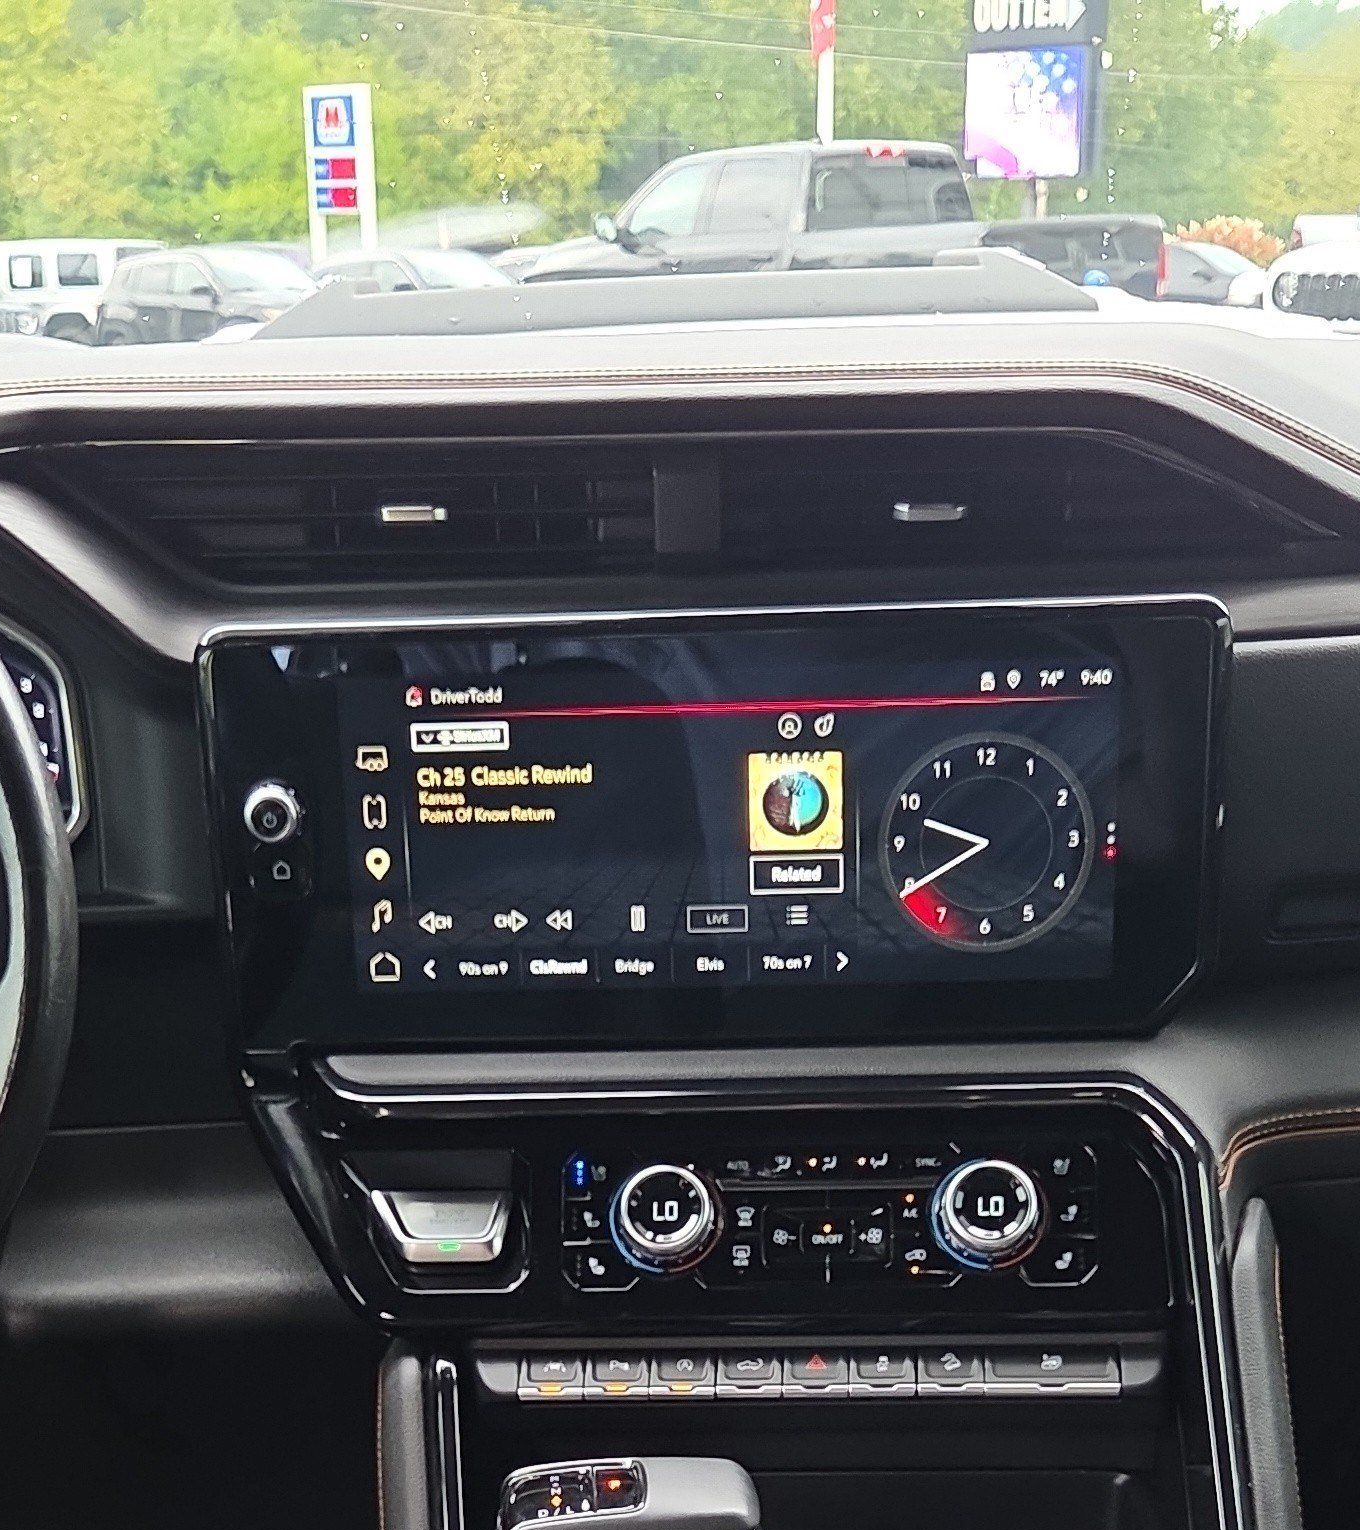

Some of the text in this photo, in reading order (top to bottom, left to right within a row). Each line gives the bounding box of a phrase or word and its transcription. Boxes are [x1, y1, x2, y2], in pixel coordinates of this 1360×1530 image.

[1080, 669, 1113, 686] 9:40
[976, 747, 996, 766] 12
[416, 763, 593, 787] Ch 25 Classic Rewind
[932, 760, 952, 778] 11
[1026, 758, 1035, 776] 1
[418, 790, 466, 806] Kansas
[900, 793, 921, 811] 10
[1056, 789, 1068, 807] 2
[419, 805, 556, 824] Point Of Know Return
[893, 835, 905, 852] 9
[1068, 830, 1080, 848] 3
[771, 865, 822, 883] Related
[1053, 873, 1066, 891] 4
[706, 913, 730, 926] LIVE
[936, 905, 948, 923] 7
[1022, 905, 1035, 922] 5
[979, 917, 992, 935] 6
[458, 961, 509, 977] 90s on 9
[614, 958, 655, 976] Bridge
[696, 956, 725, 972] Elvis
[762, 954, 813, 970] 70s on 7
[652, 1201, 679, 1223] LO
[977, 1195, 1005, 1217] LO
